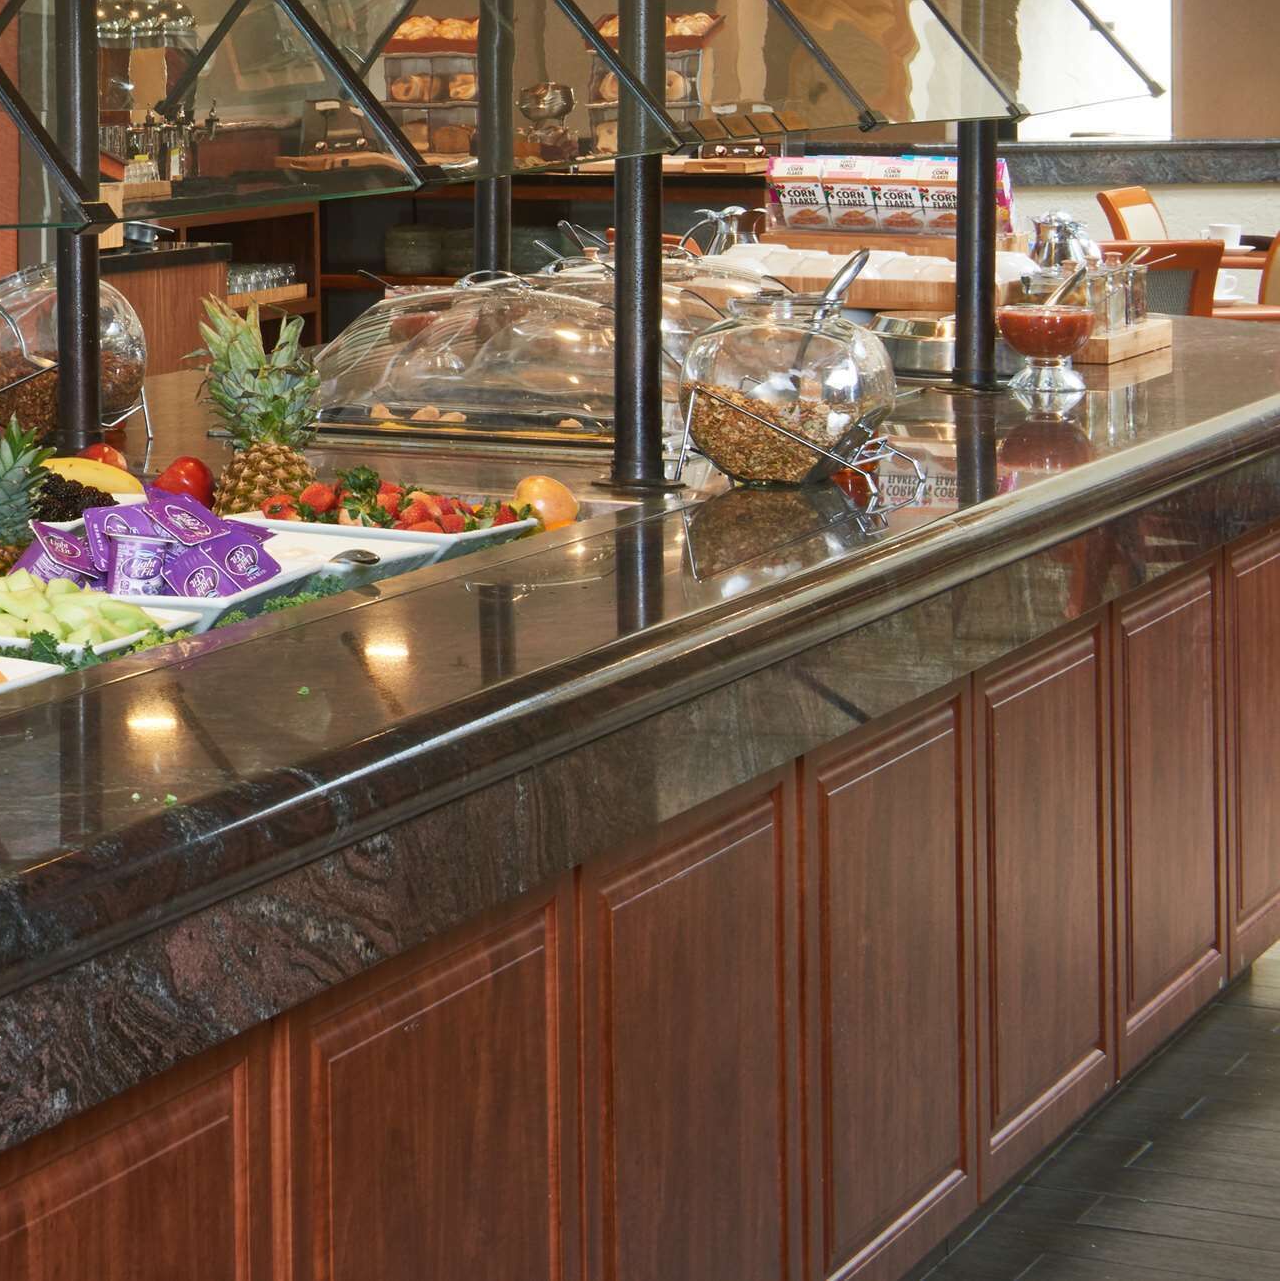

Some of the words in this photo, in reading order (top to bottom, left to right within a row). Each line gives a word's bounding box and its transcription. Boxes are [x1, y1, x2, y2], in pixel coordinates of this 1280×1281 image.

[787, 189, 816, 198] CORN
[836, 191, 865, 199] CORN
[883, 192, 912, 200] CORN
[838, 199, 867, 207] FLAKES
[885, 200, 915, 208] FLAKES
[933, 201, 957, 209] FLAKE
[131, 559, 157, 569] Light
